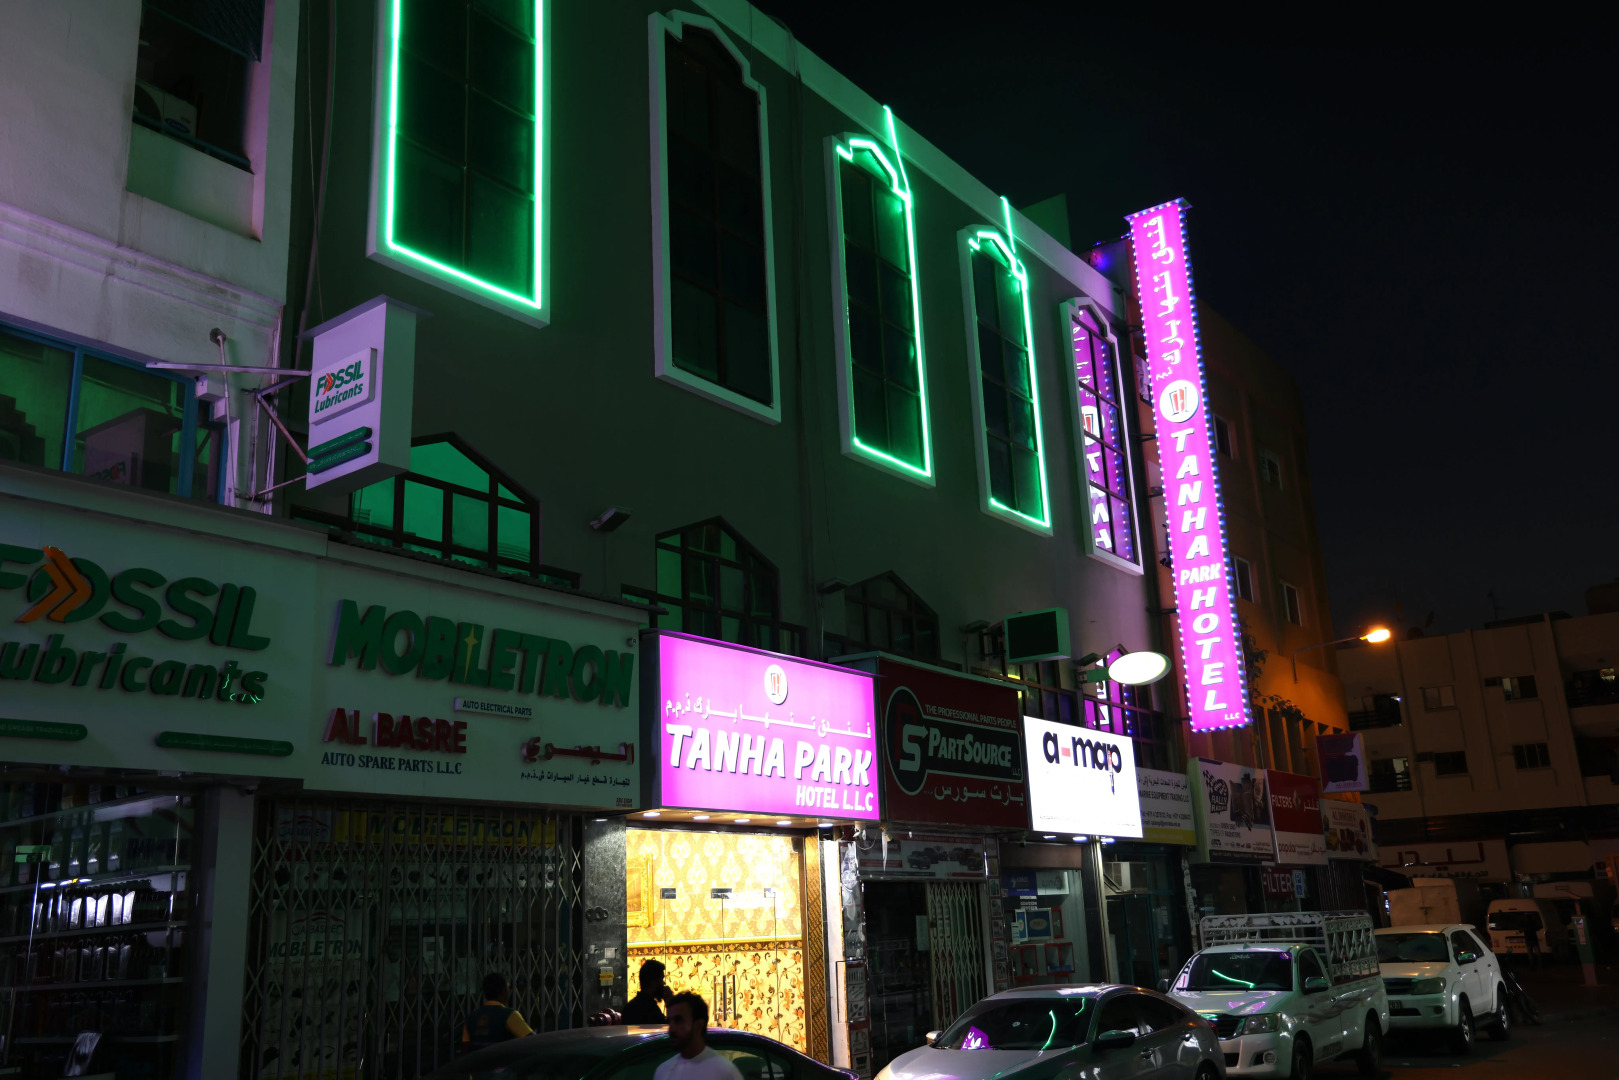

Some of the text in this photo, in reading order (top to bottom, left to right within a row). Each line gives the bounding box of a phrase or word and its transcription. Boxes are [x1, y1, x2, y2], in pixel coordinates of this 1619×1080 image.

[1143, 215, 1174, 264] فندق
[316, 361, 364, 397] FOSSIL
[315, 383, 363, 413] Lubricants
[1171, 428, 1210, 560] TANHA
[1180, 563, 1221, 586] PARK
[328, 599, 634, 708] MOBILETRON
[1190, 586, 1228, 712] HOTEL
[462, 700, 532, 716] AUTO ELECTRICAL PARTS
[694, 696, 737, 722] بارك
[740, 704, 815, 730] تنها
[925, 704, 1017, 729] THE PROFESSIONAL PARTS PEOPLE
[325, 708, 467, 753] AL BASRE
[817, 718, 871, 738] فندق
[321, 752, 462, 775] AUTO SPARE PARTS L.L.C
[666, 723, 872, 786] TANHA PARK
[795, 785, 839, 810] HOTEL
[934, 785, 1024, 806] بارت سورس
[1211, 795, 1227, 805] RALLY
[1271, 794, 1293, 809] FILTERS
